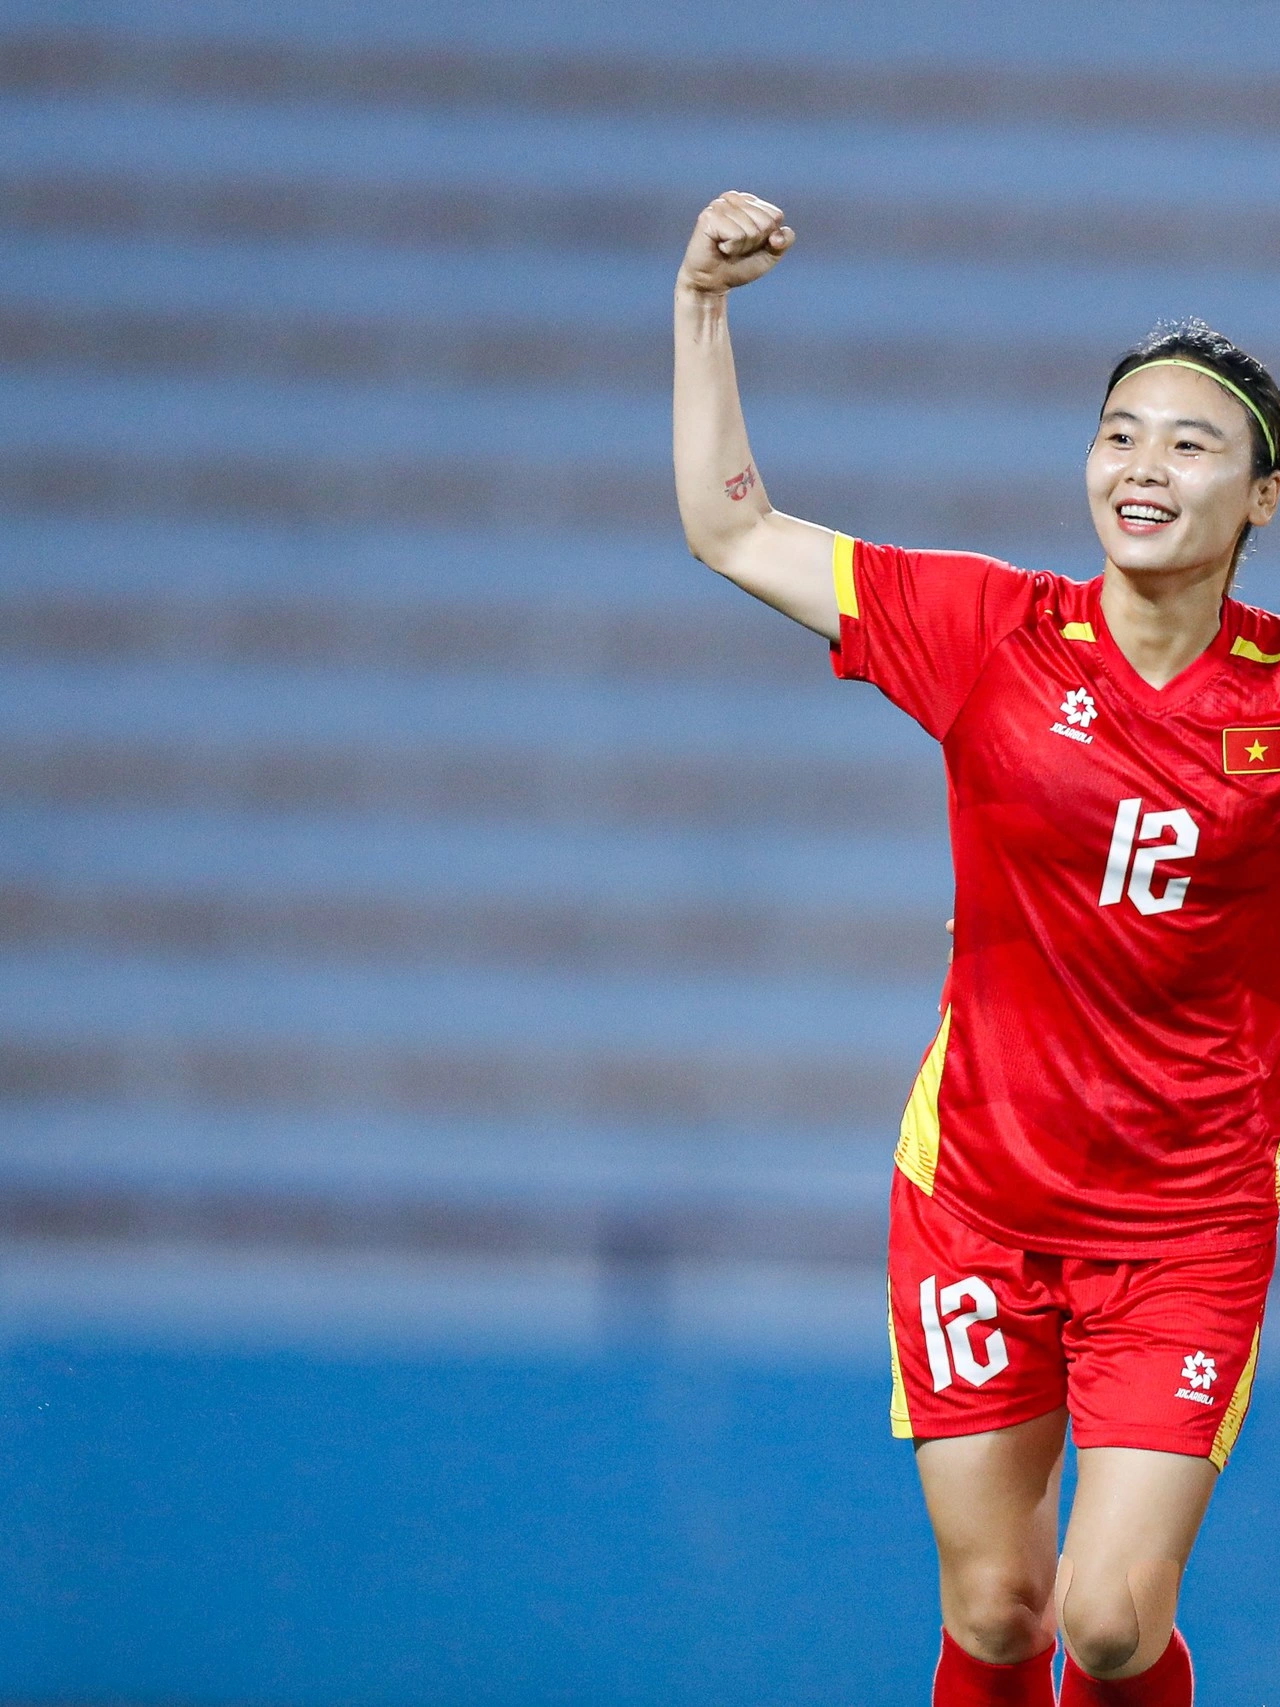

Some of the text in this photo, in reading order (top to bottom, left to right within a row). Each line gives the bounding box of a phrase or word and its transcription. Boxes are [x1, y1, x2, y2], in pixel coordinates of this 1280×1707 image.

[1049, 722, 1094, 745] JOGARBOLA
[1098, 797, 1200, 916] 12
[919, 1274, 1010, 1394] 12
[1173, 1388, 1215, 1406] JOGARBOLA
